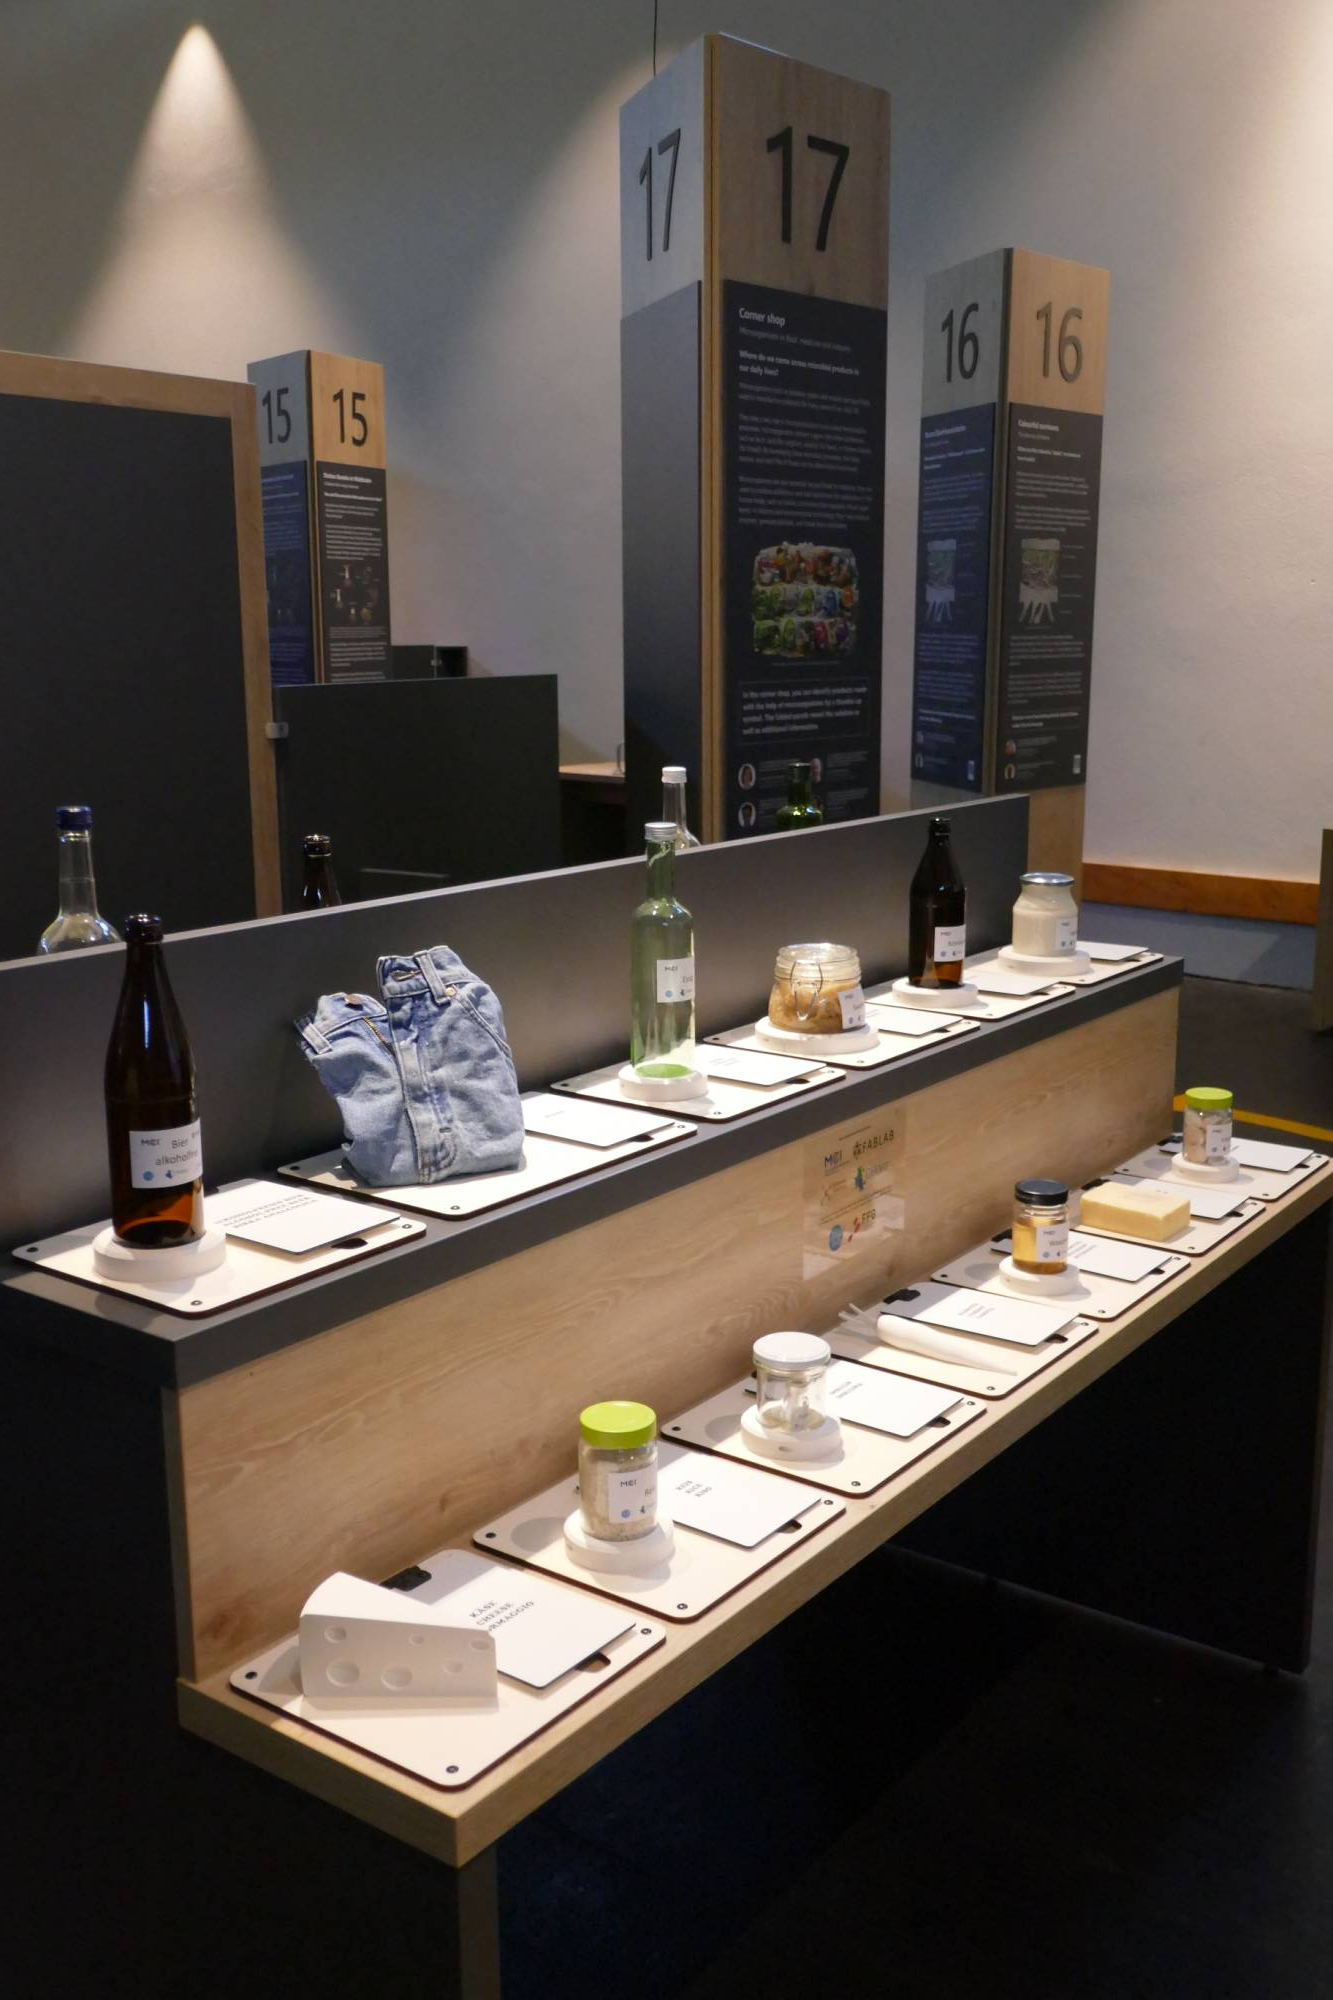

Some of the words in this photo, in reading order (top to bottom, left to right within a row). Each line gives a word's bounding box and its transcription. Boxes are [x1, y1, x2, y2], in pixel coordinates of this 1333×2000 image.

[638, 127, 682, 262] 17
[765, 125, 851, 253] 17
[738, 308, 765, 322] Corner
[767, 312, 786, 327] shop
[941, 301, 980, 384] 16
[1035, 301, 1084, 383] 16
[739, 350, 757, 361] Where
[749, 366, 763, 377] daily
[262, 387, 292, 445] 15
[332, 388, 368, 447] 15
[171, 1138, 189, 1149] Bier
[862, 1129, 894, 1153] FABLAB
[469, 1601, 496, 1618] KÄSE
[476, 1602, 513, 1626] CHEESE
